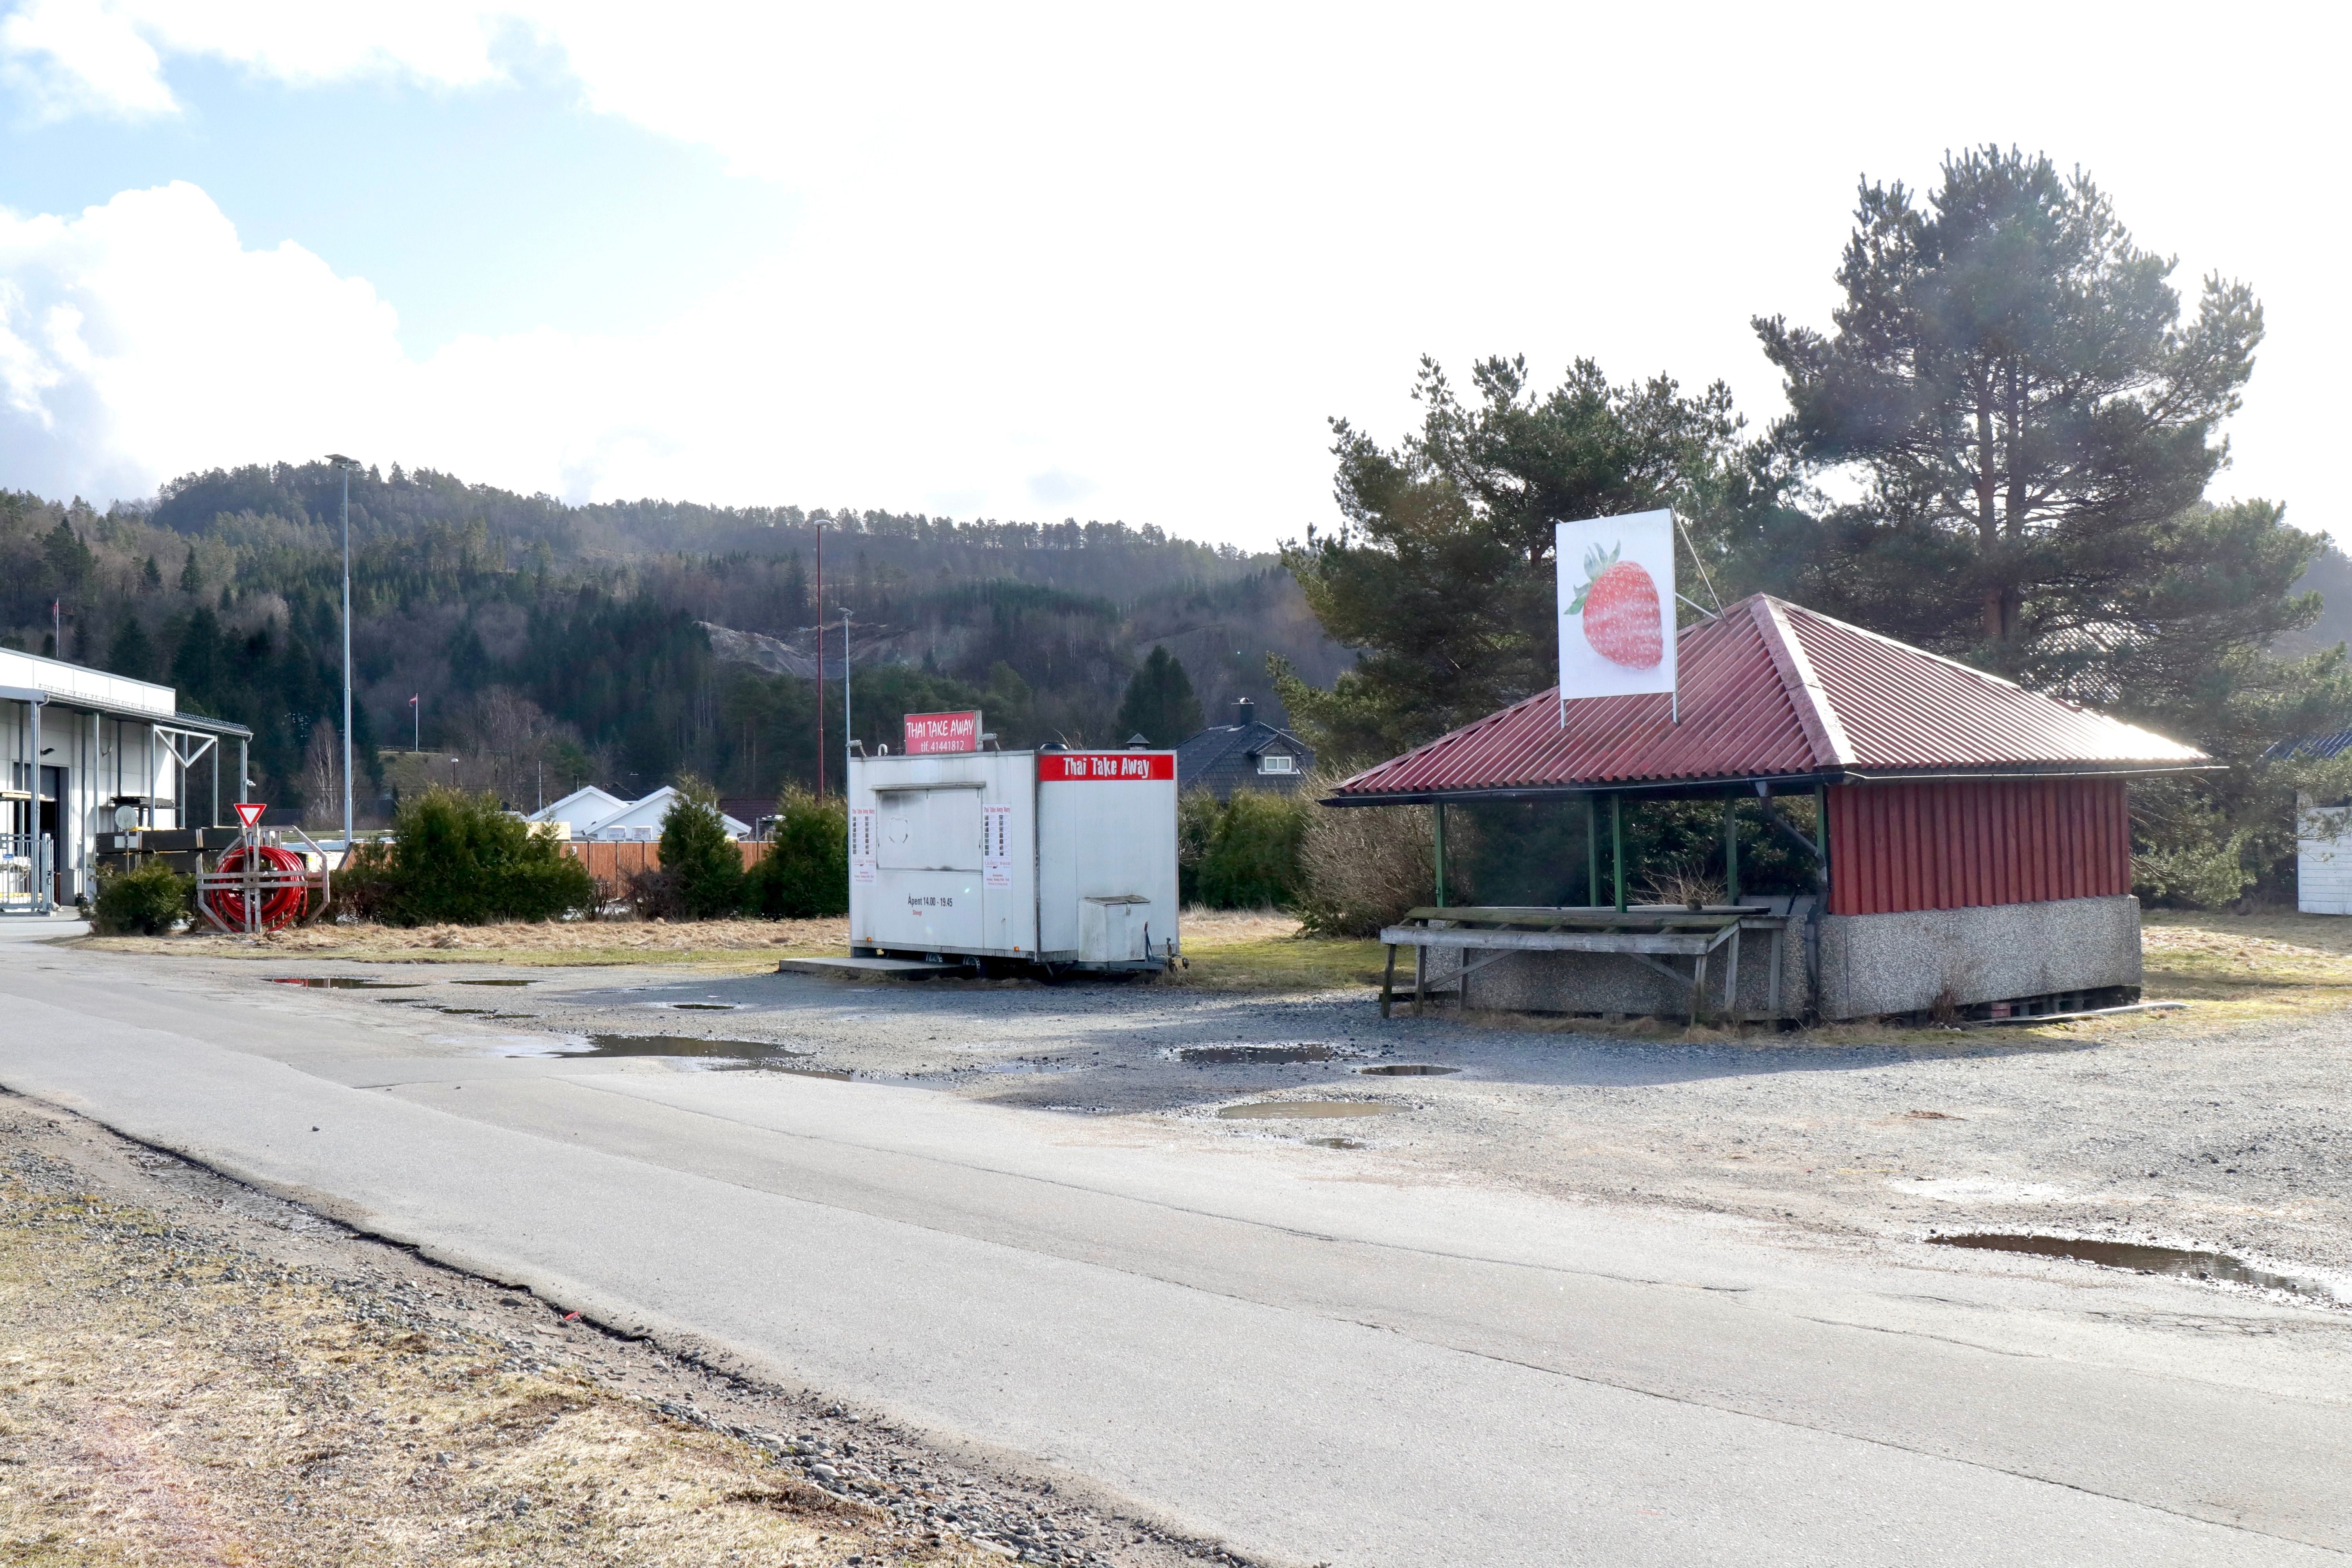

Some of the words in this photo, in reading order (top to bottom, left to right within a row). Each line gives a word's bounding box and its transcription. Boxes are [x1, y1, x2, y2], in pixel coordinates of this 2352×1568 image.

[906, 721, 925, 739] THAI
[927, 720, 948, 738] TAKE
[950, 719, 973, 737] AWAY
[921, 741, 929, 752] tlf.
[931, 740, 964, 751] 41441812
[1063, 757, 1087, 775] Thai
[1091, 757, 1117, 777] Take
[1121, 757, 1149, 779] Away
[908, 893, 922, 907] Åpent
[924, 897, 936, 906] 14.00
[940, 897, 953, 907] 19.45
